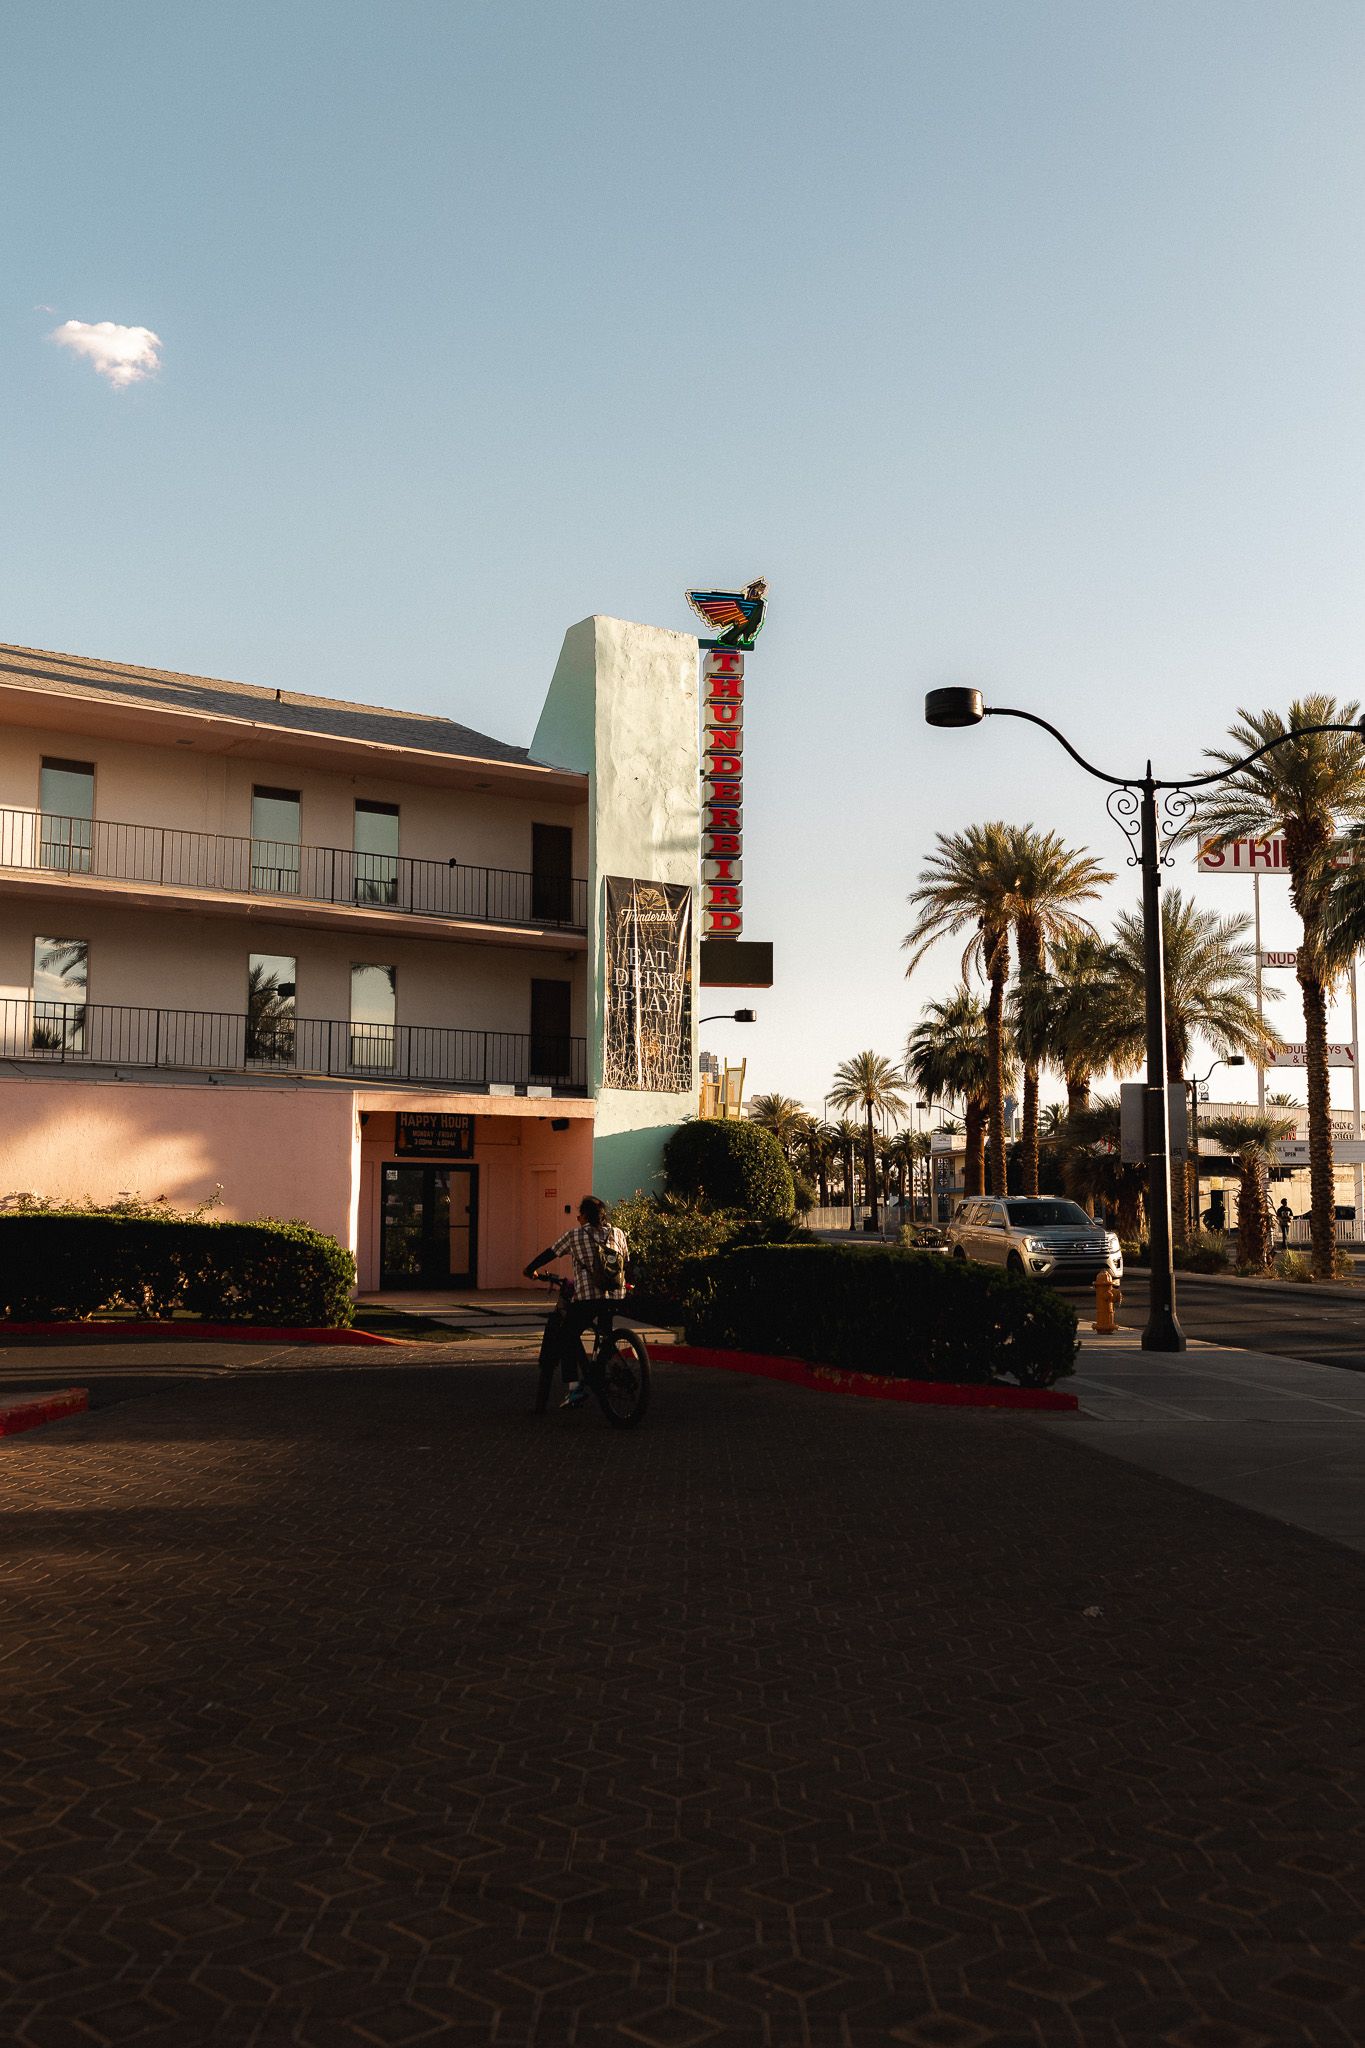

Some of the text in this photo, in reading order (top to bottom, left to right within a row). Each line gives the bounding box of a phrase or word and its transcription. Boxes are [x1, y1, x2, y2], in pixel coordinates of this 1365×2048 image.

[708, 654, 742, 930] THUNDERBIRD
[621, 908, 679, 927] Thunderbird
[627, 947, 671, 969] EAT
[1267, 953, 1298, 965] NUD
[613, 967, 683, 992] DRINK
[1285, 1045, 1308, 1054] DUL
[400, 1113, 470, 1129] HAPPY HOUR
